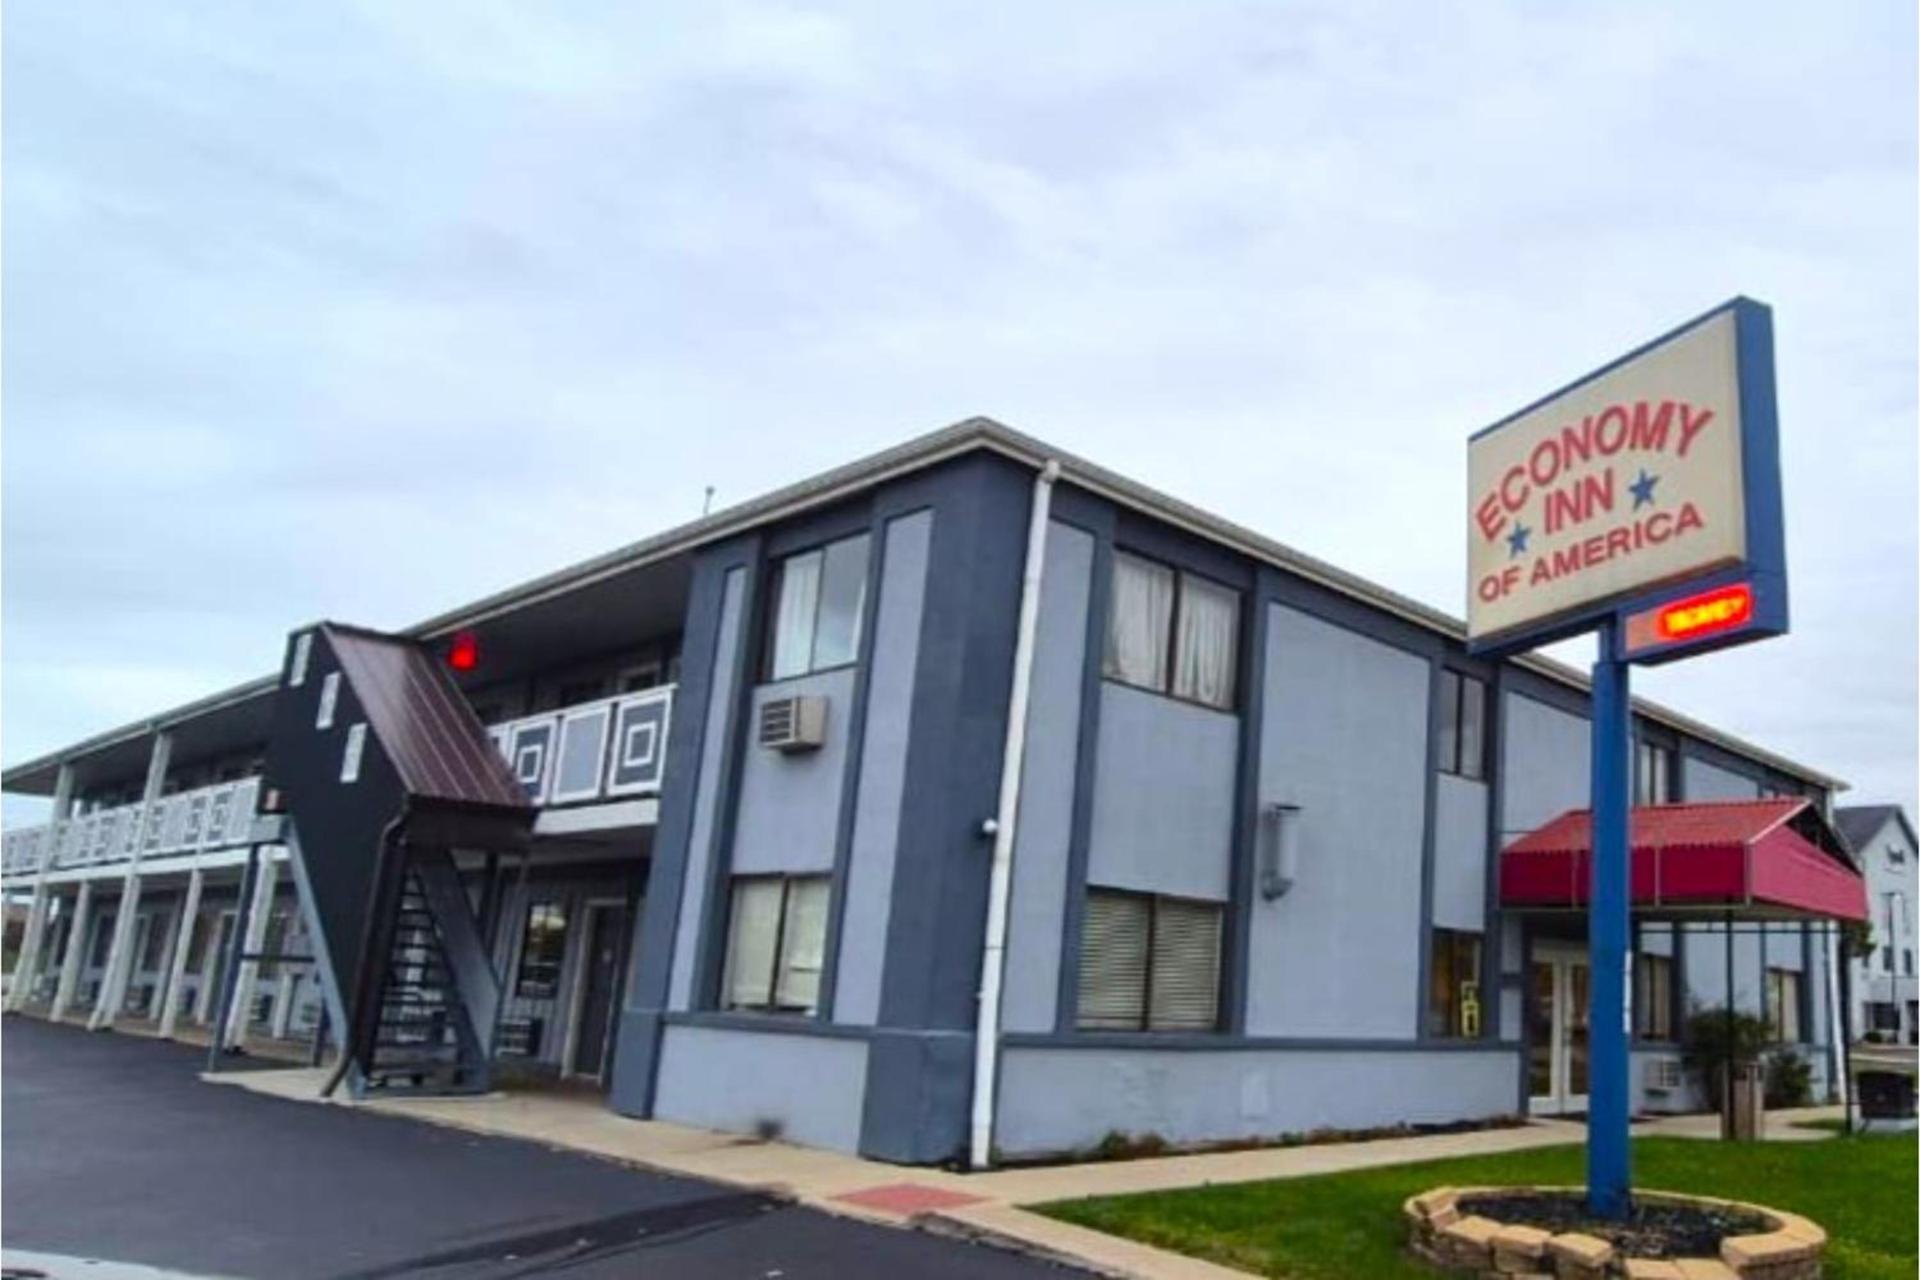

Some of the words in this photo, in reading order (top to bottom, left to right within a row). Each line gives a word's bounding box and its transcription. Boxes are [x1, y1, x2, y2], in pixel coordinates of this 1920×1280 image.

[1475, 399, 1714, 542] ECONOMY
[1543, 468, 1614, 535] INN
[1478, 566, 1521, 602] OF
[1530, 502, 1704, 586] AMERICA
